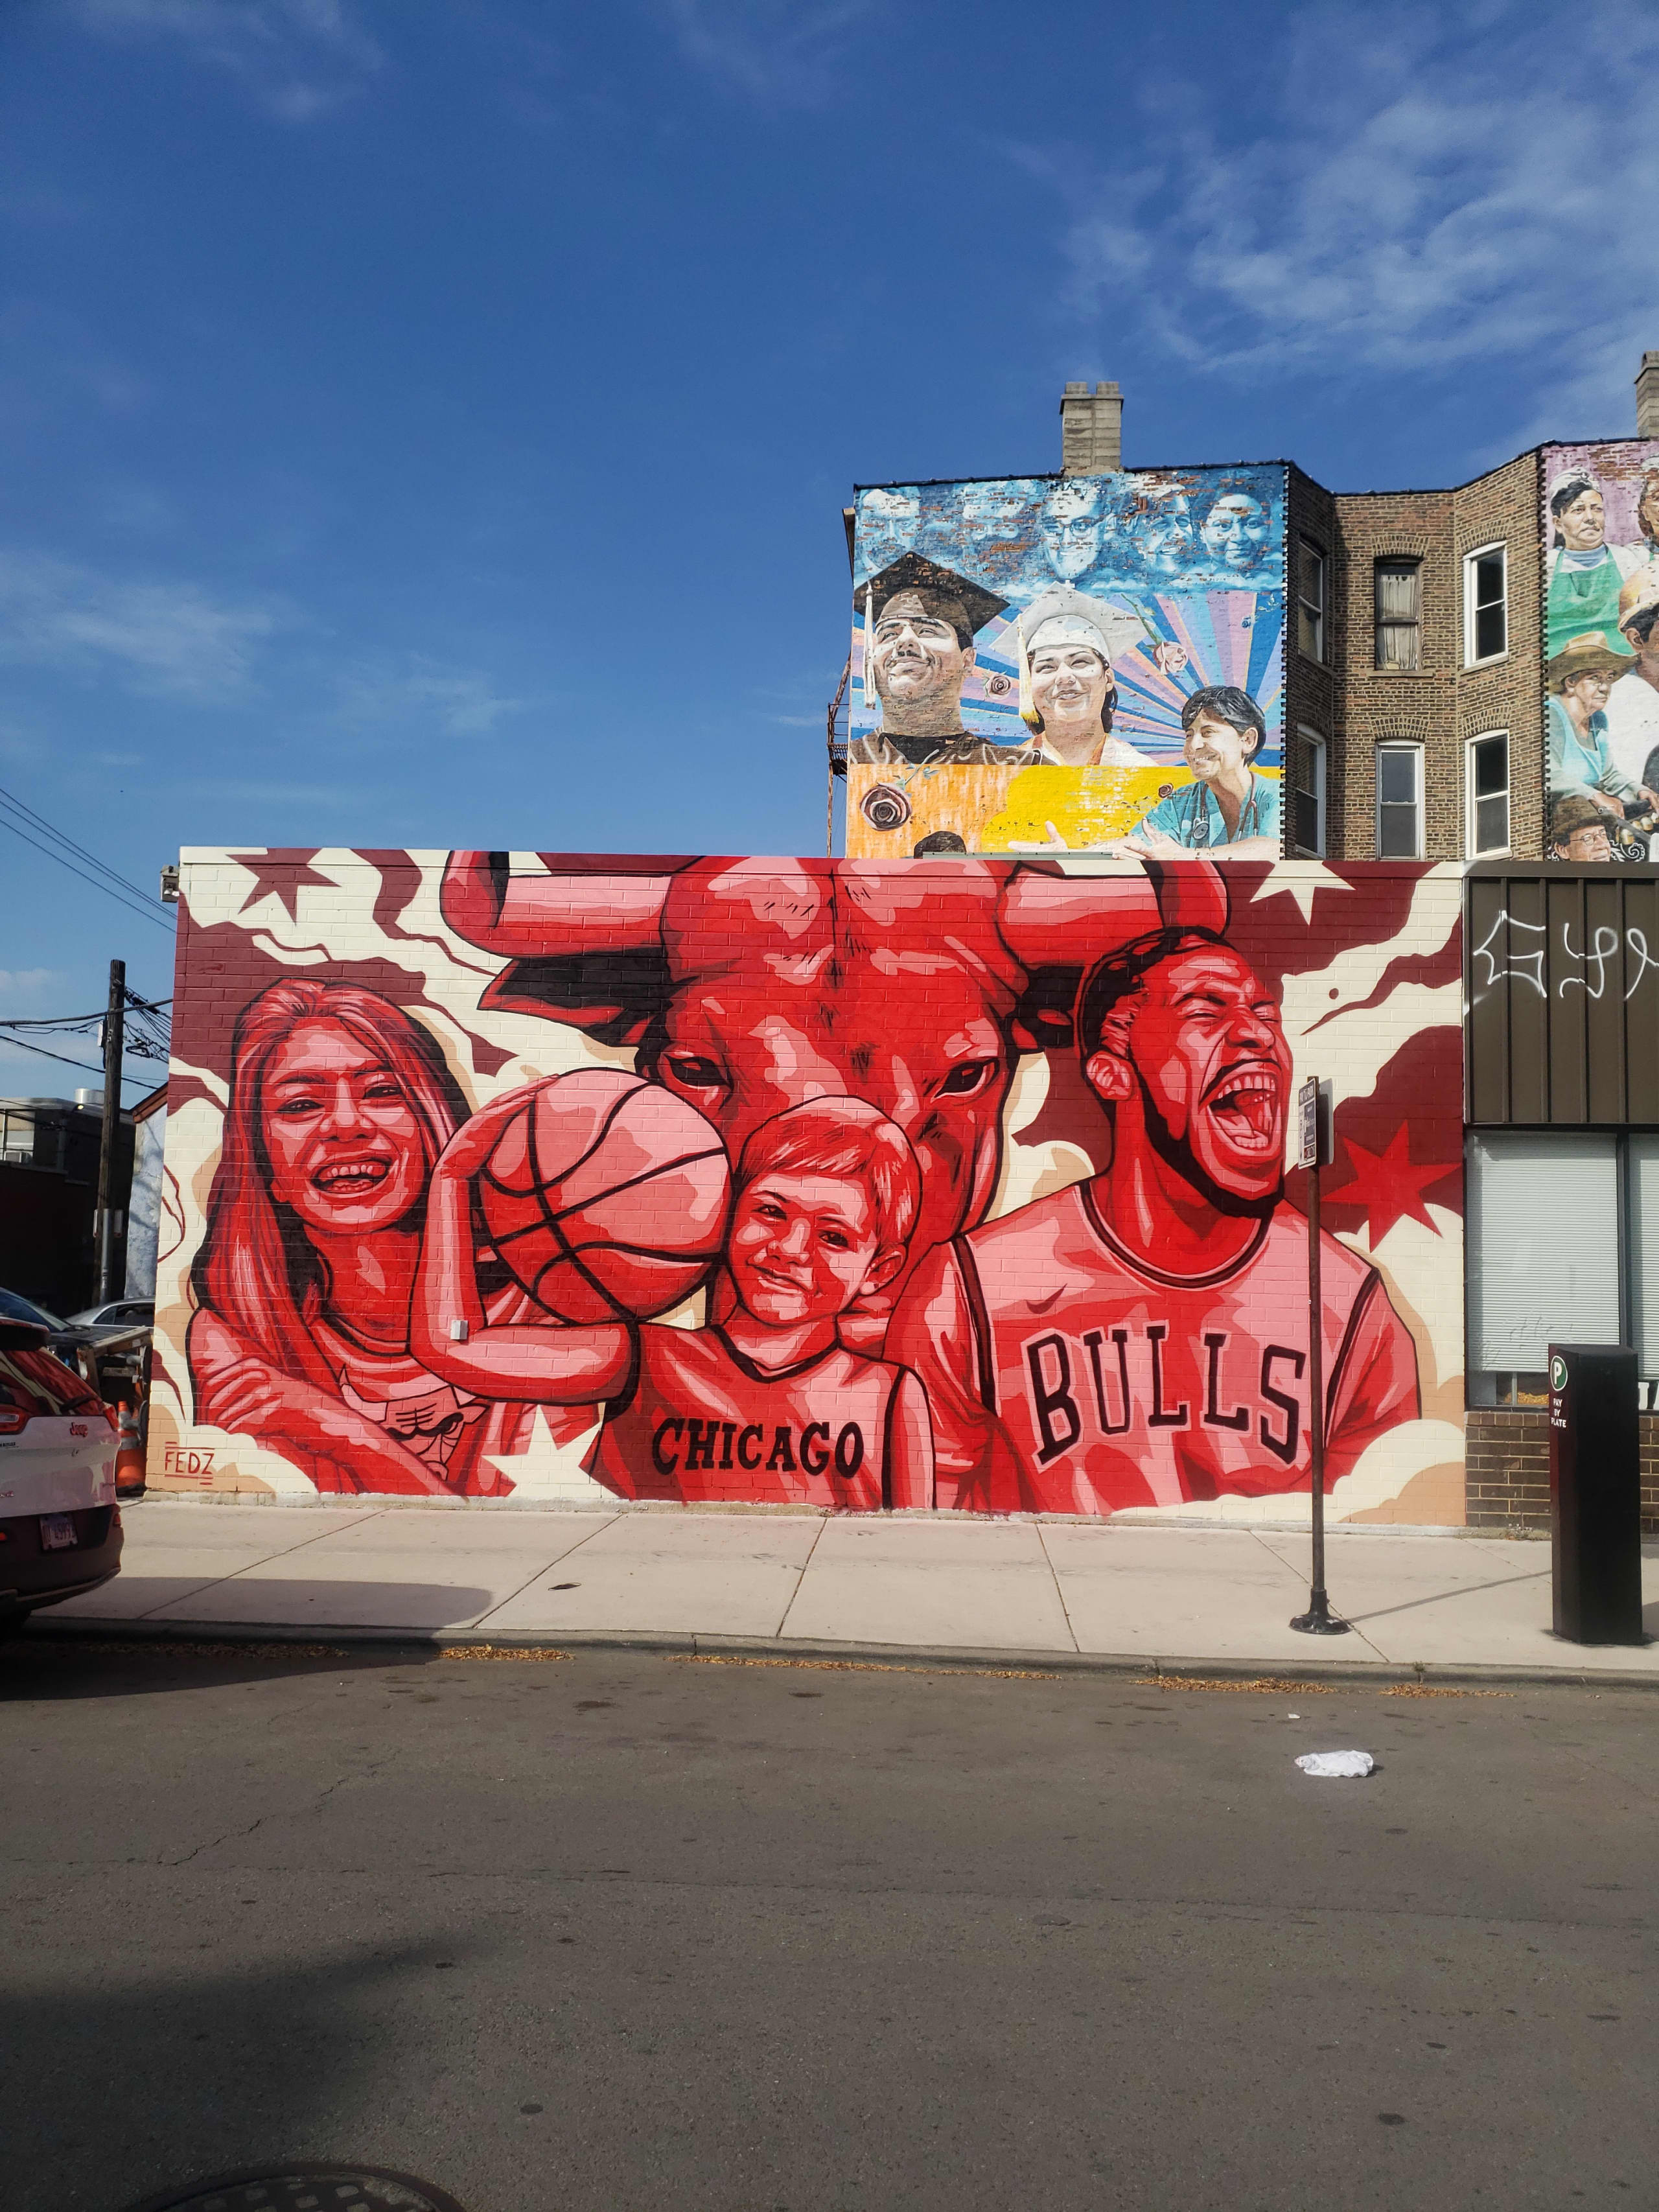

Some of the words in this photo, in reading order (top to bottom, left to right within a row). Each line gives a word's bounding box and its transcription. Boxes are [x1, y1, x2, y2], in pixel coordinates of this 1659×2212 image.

[1554, 1361, 1562, 1384] P
[1027, 1325, 1306, 1465] BULLS
[1553, 1398, 1562, 1407] PAY
[1554, 1408, 1560, 1417] BY
[70, 1422, 88, 1438] Jeep
[1551, 1417, 1566, 1428] PLATE
[652, 1417, 864, 1479] CHICAGO
[165, 1451, 215, 1474] FEDZ
